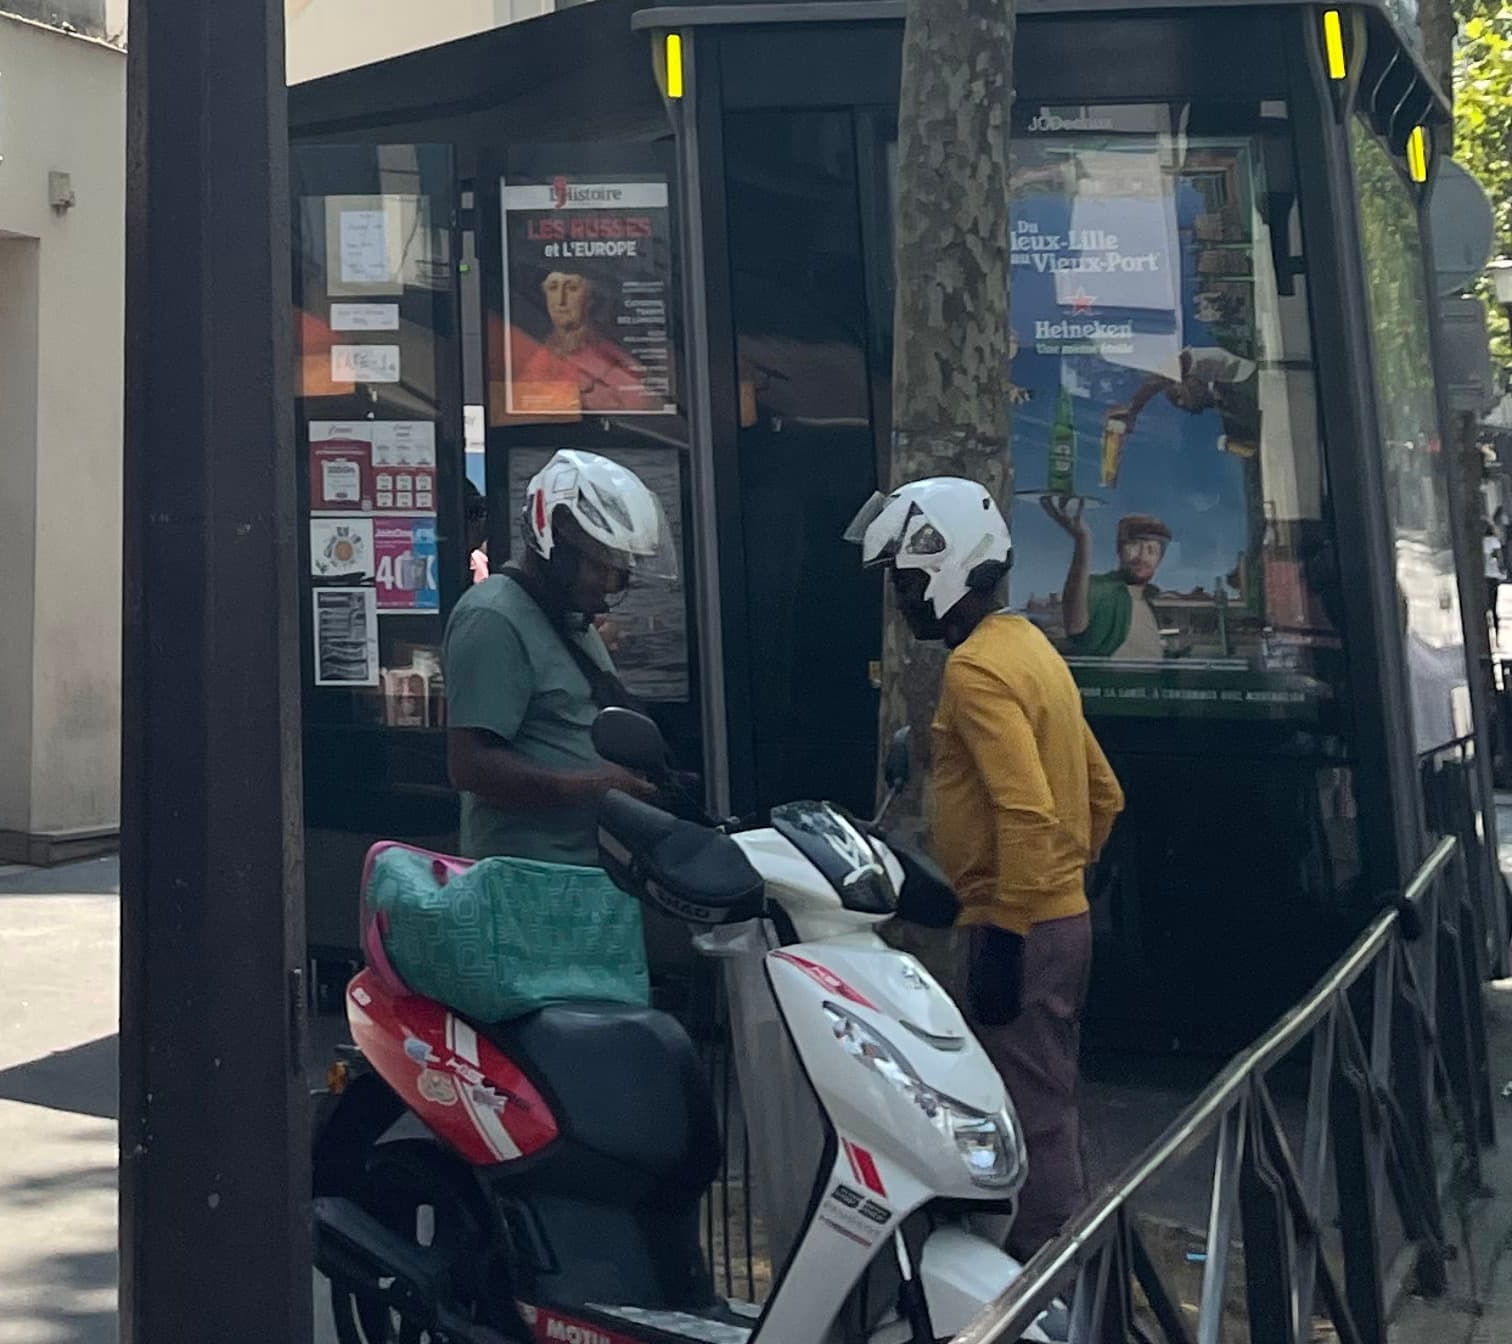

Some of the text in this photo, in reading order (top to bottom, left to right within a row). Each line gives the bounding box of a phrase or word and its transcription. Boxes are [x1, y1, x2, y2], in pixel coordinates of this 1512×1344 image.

[1018, 221, 1038, 233] Du
[545, 241, 636, 257] et L'EUROPE
[1010, 230, 1119, 250] ieux-Lille
[1034, 252, 1160, 273] Vieux-Port
[1035, 321, 1133, 339] Heineken
